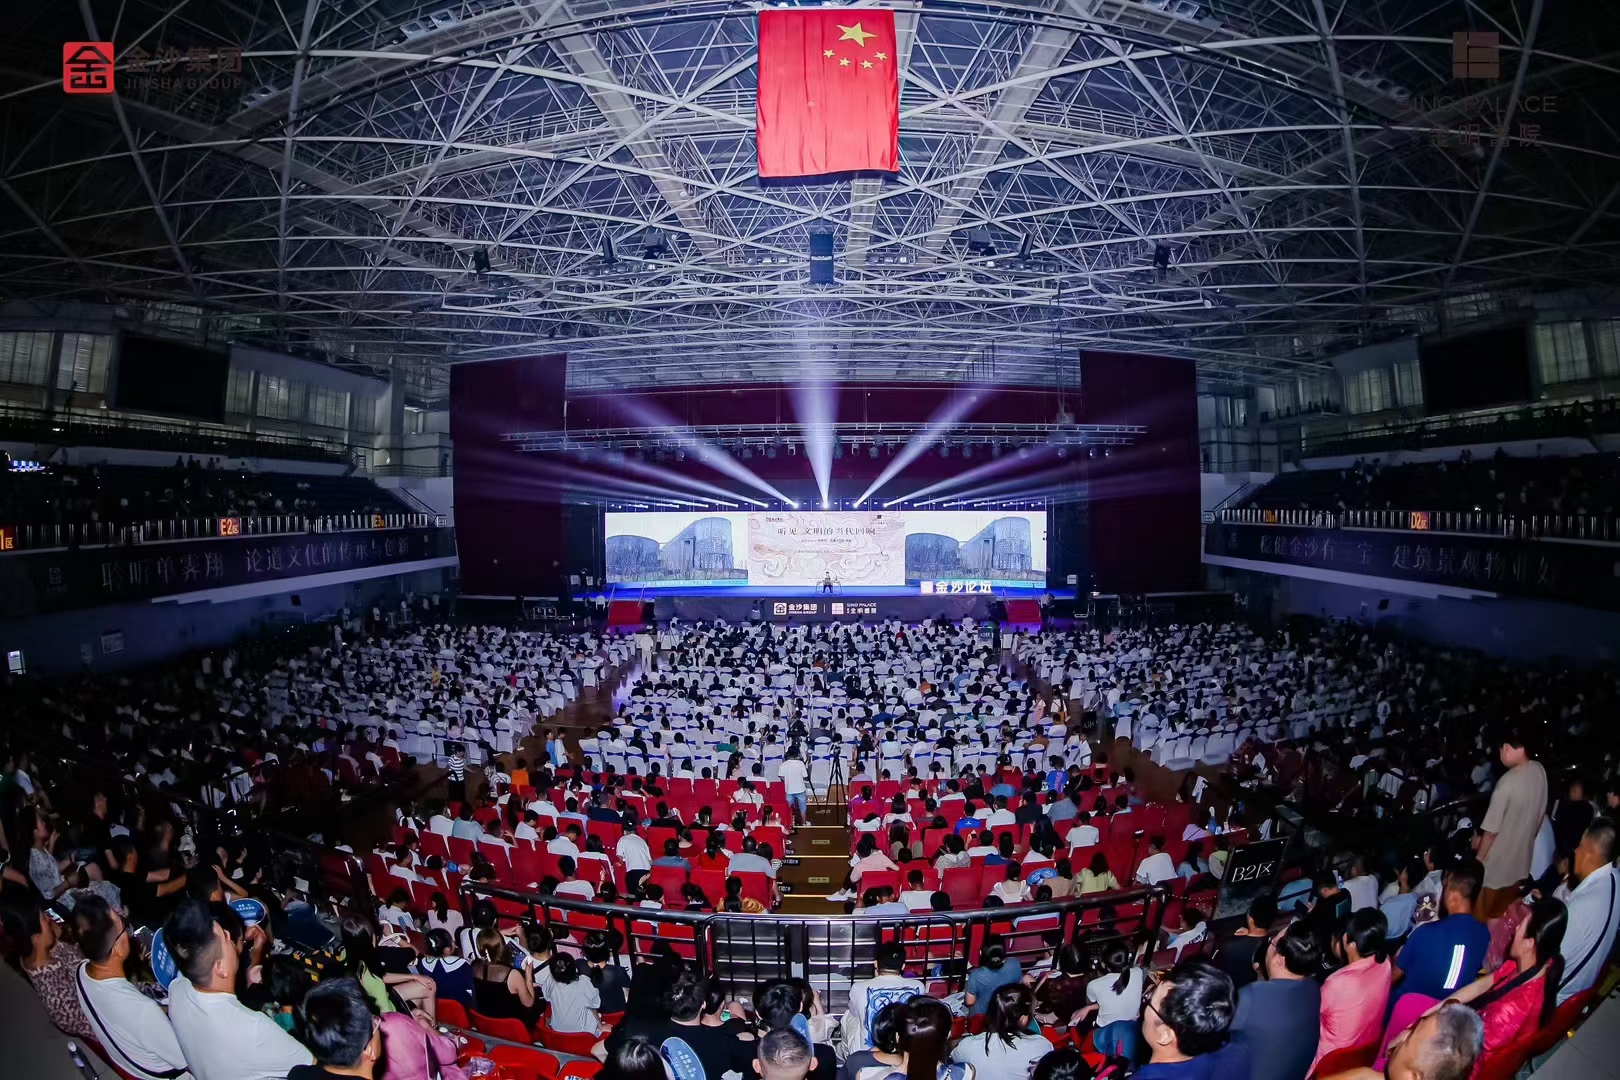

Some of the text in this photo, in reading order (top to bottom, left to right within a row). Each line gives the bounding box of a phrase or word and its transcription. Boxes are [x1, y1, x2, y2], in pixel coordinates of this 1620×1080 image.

[220, 518, 239, 536] E2区
[1411, 513, 1428, 530] D2区
[777, 527, 876, 536] 听见 文明的当代回响
[935, 581, 992, 594] 金沙论坛
[788, 603, 818, 611] 金沙集团
[1231, 860, 1276, 883] B2区
